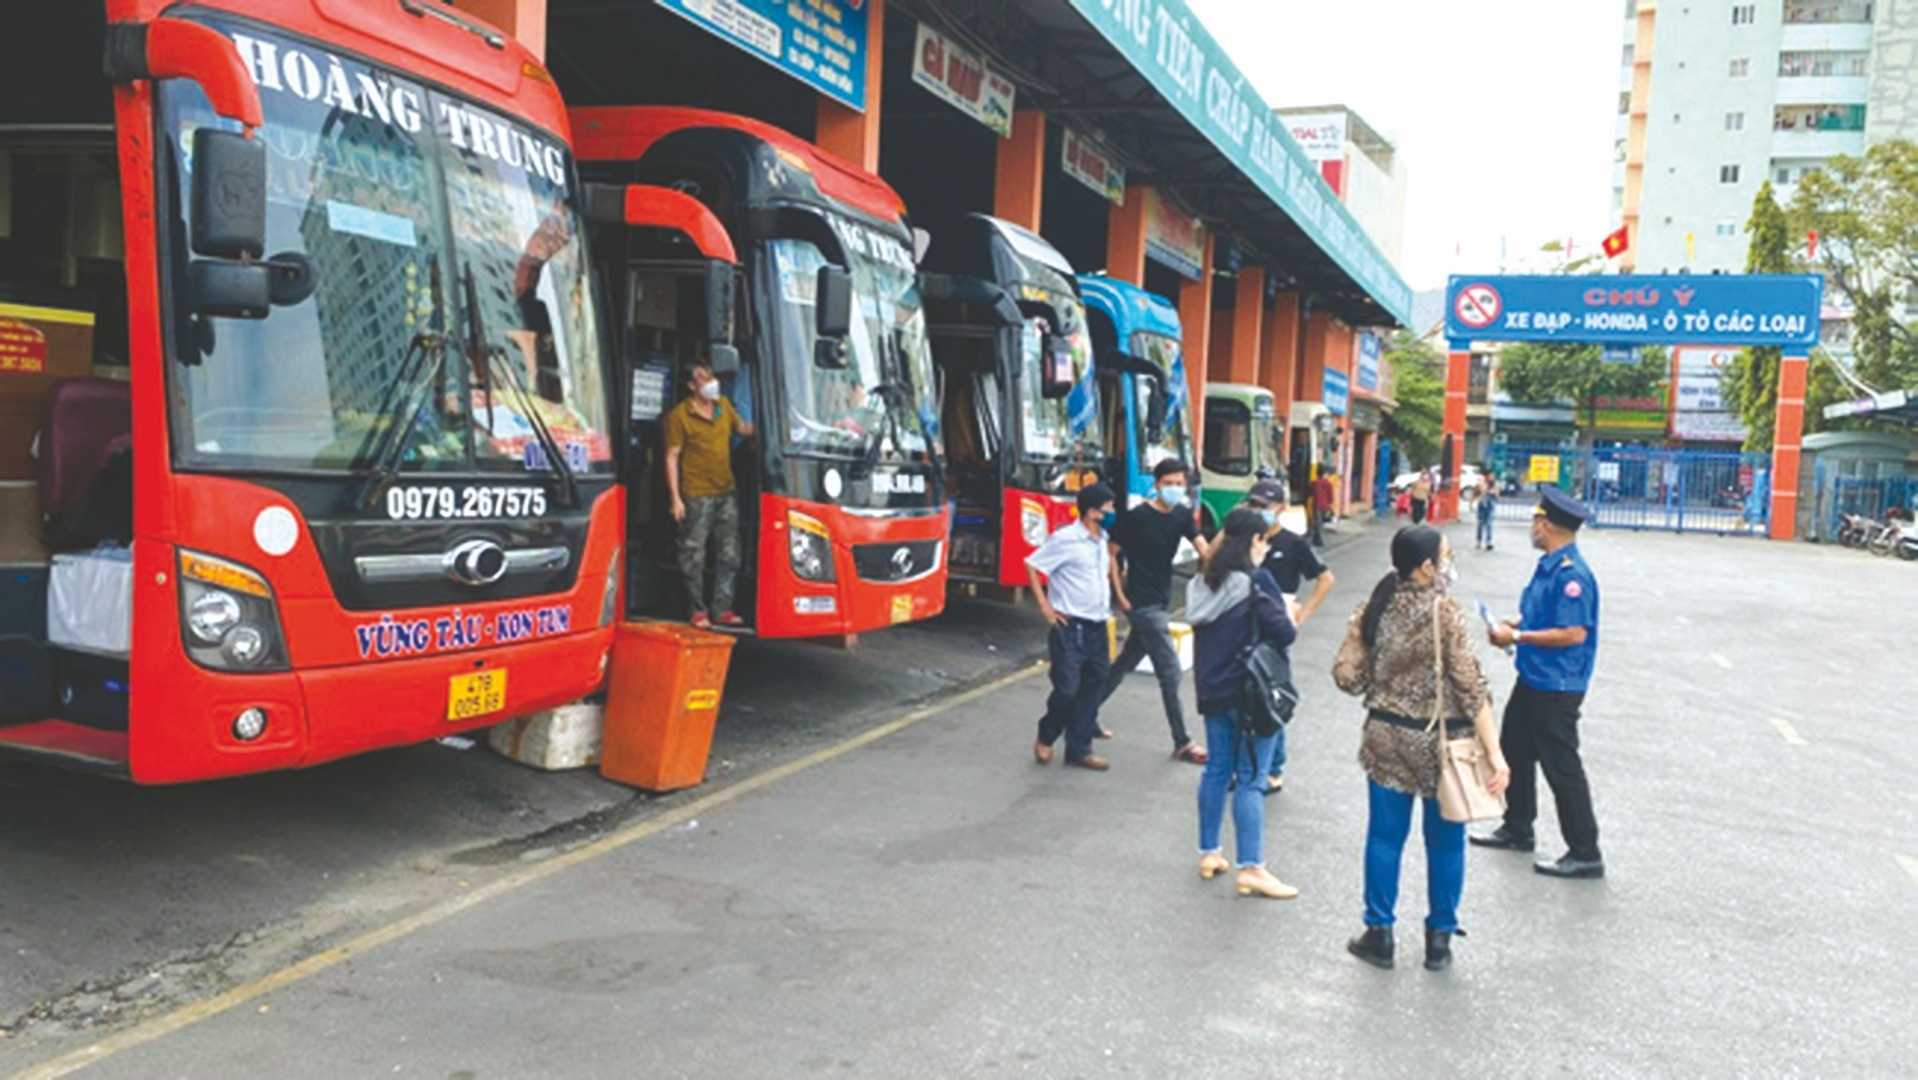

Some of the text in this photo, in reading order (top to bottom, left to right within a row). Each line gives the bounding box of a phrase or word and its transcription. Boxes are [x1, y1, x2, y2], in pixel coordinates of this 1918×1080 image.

[232, 33, 565, 186] HOÀNG TRUNG
[1583, 284, 1696, 306] CHÚ Ý
[1504, 312, 1530, 329] XE
[1533, 312, 1571, 334] ĐẠP
[1584, 312, 1648, 331] HONDA
[1663, 309, 1678, 331] Ô
[1684, 310, 1710, 332] TÔ
[1713, 309, 1755, 332] CÁC
[1759, 314, 1806, 337] LOẠI
[386, 486, 547, 520] 0979.267575
[356, 612, 429, 655] VŨNG
[436, 606, 482, 648] TÀU
[496, 611, 534, 642] KON
